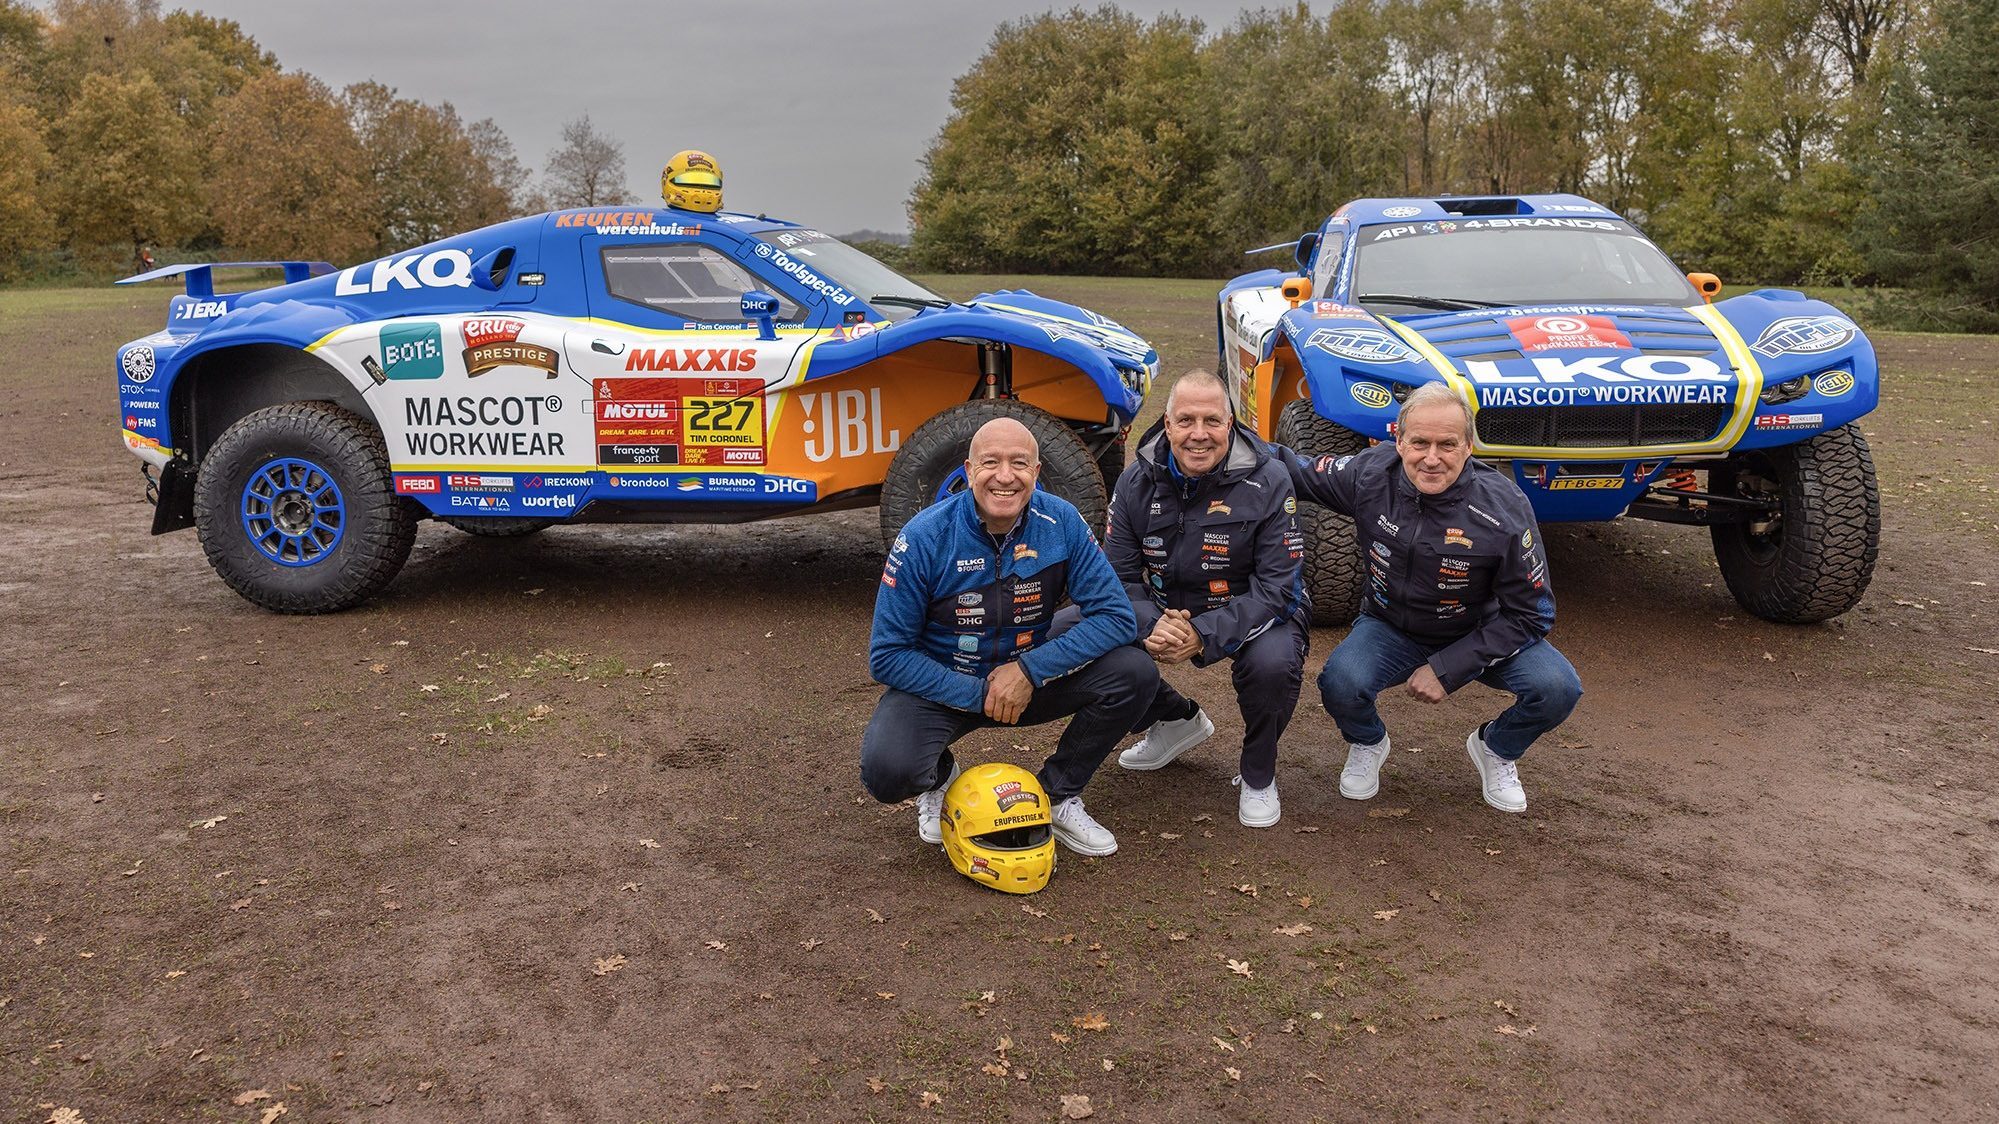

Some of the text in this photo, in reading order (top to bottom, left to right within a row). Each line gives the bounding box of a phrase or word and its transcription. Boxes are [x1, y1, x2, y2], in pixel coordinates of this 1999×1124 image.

[556, 212, 653, 228] KEUKEN
[1374, 225, 1417, 241] API
[335, 249, 473, 297] LKQ
[771, 249, 857, 306] Toolspecial
[742, 300, 768, 310] DHG
[1547, 334, 1597, 342] PROFILE
[473, 348, 548, 362] PRESTIGE
[624, 349, 757, 372] MAXXIS
[1464, 355, 1735, 384] LKQ
[121, 384, 145, 394] STOX
[1818, 373, 1853, 392] HELLA
[1355, 387, 1391, 403] HELLA
[1591, 386, 1728, 405] WORKWEAR
[603, 403, 669, 418] MOTUL
[690, 400, 755, 431] 227
[803, 387, 900, 463] JBL
[405, 432, 565, 456] WORKWEAR
[690, 435, 755, 443] TIM CORONEL
[633, 454, 660, 464] sport
[725, 452, 761, 460] MOTUL
[402, 479, 435, 490] FEBO
[709, 477, 756, 487] BURANDO
[764, 479, 807, 493] DHG
[451, 496, 510, 507] BATAVIA
[522, 494, 576, 508] wortell
[957, 616, 983, 626] DHG
[1001, 793, 1037, 805] PRESTIGE
[994, 813, 1045, 827] ERUPRESTIGE.NL
